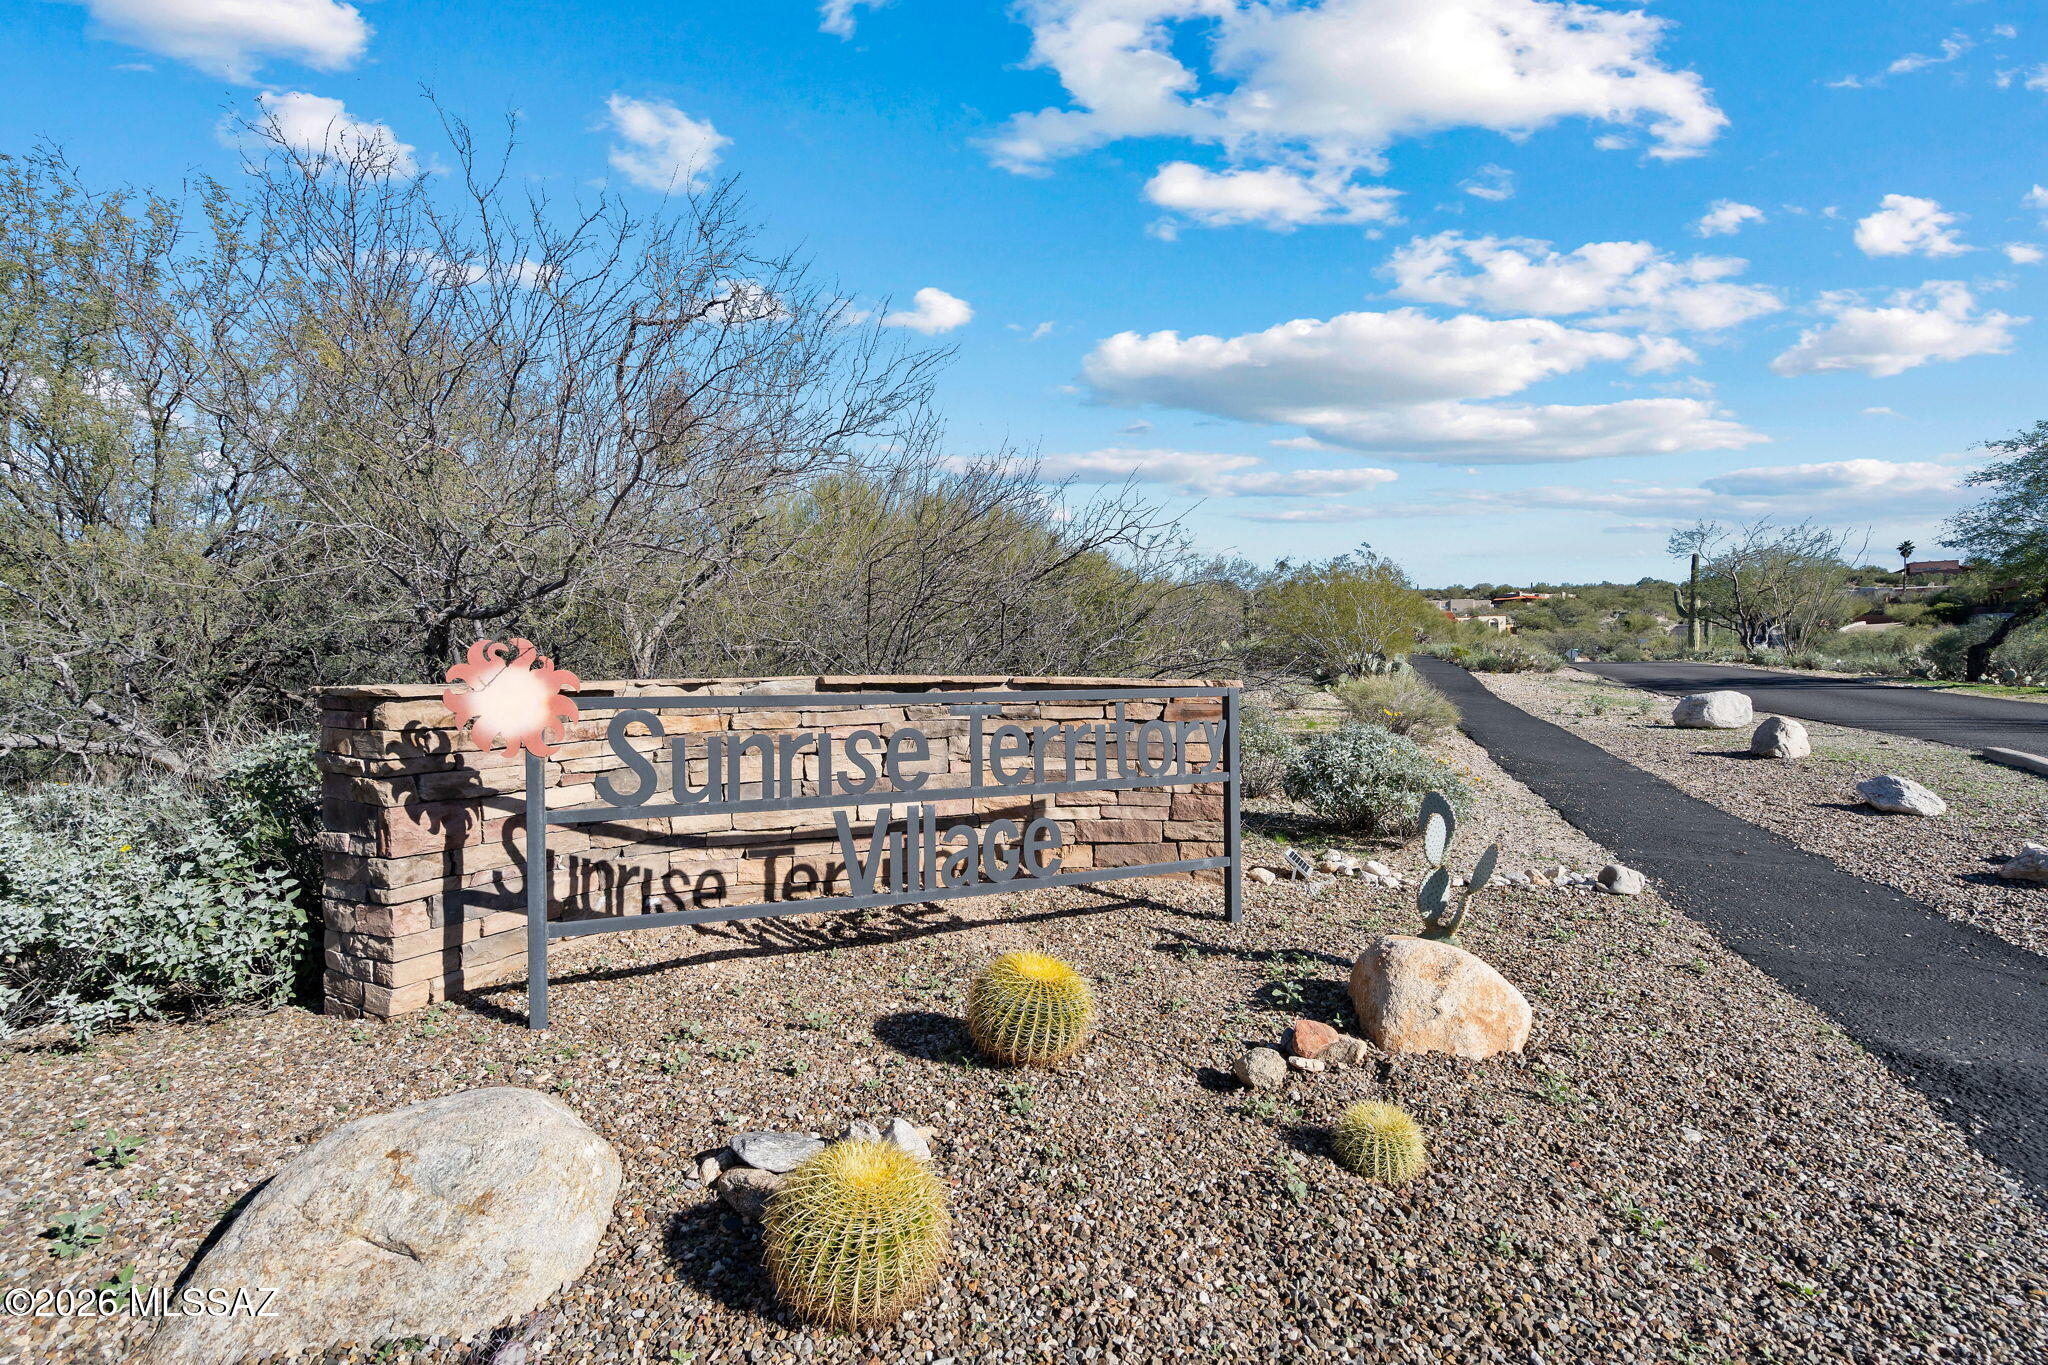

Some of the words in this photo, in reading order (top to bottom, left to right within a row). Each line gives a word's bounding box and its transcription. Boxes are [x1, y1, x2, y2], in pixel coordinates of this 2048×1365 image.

[595, 709, 930, 808] Sunrise
[950, 702, 1227, 787] Territory
[833, 804, 1063, 896] Village
